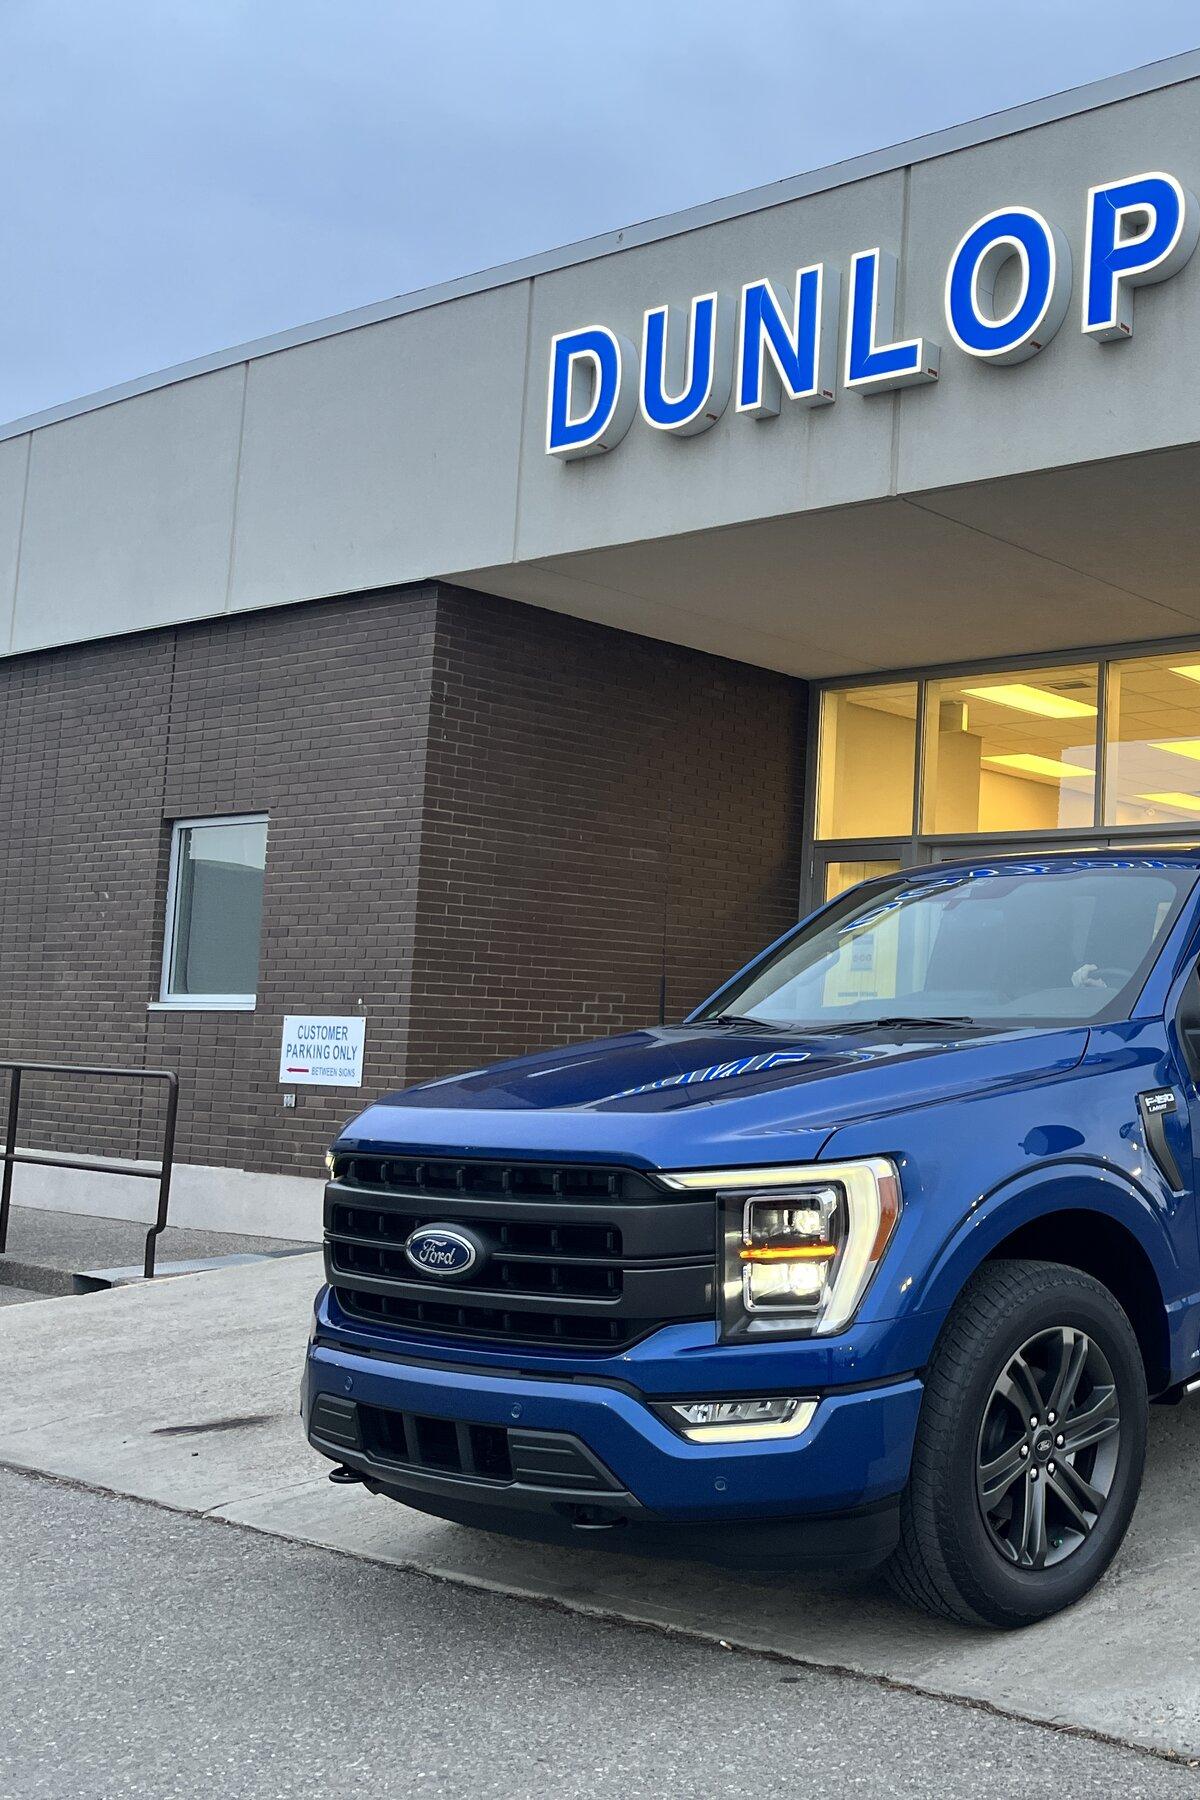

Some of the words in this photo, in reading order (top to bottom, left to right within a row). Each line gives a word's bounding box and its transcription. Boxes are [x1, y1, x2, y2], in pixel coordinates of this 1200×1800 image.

[545, 171, 1187, 455] DUNLOP
[297, 1025, 349, 1041] CUSTOMER
[285, 1044, 330, 1060] PARKING
[333, 1045, 358, 1061] ONLY
[311, 1066, 337, 1077] BETWEEN
[338, 1067, 356, 1078] SIGNS
[419, 1238, 456, 1265] Ford
